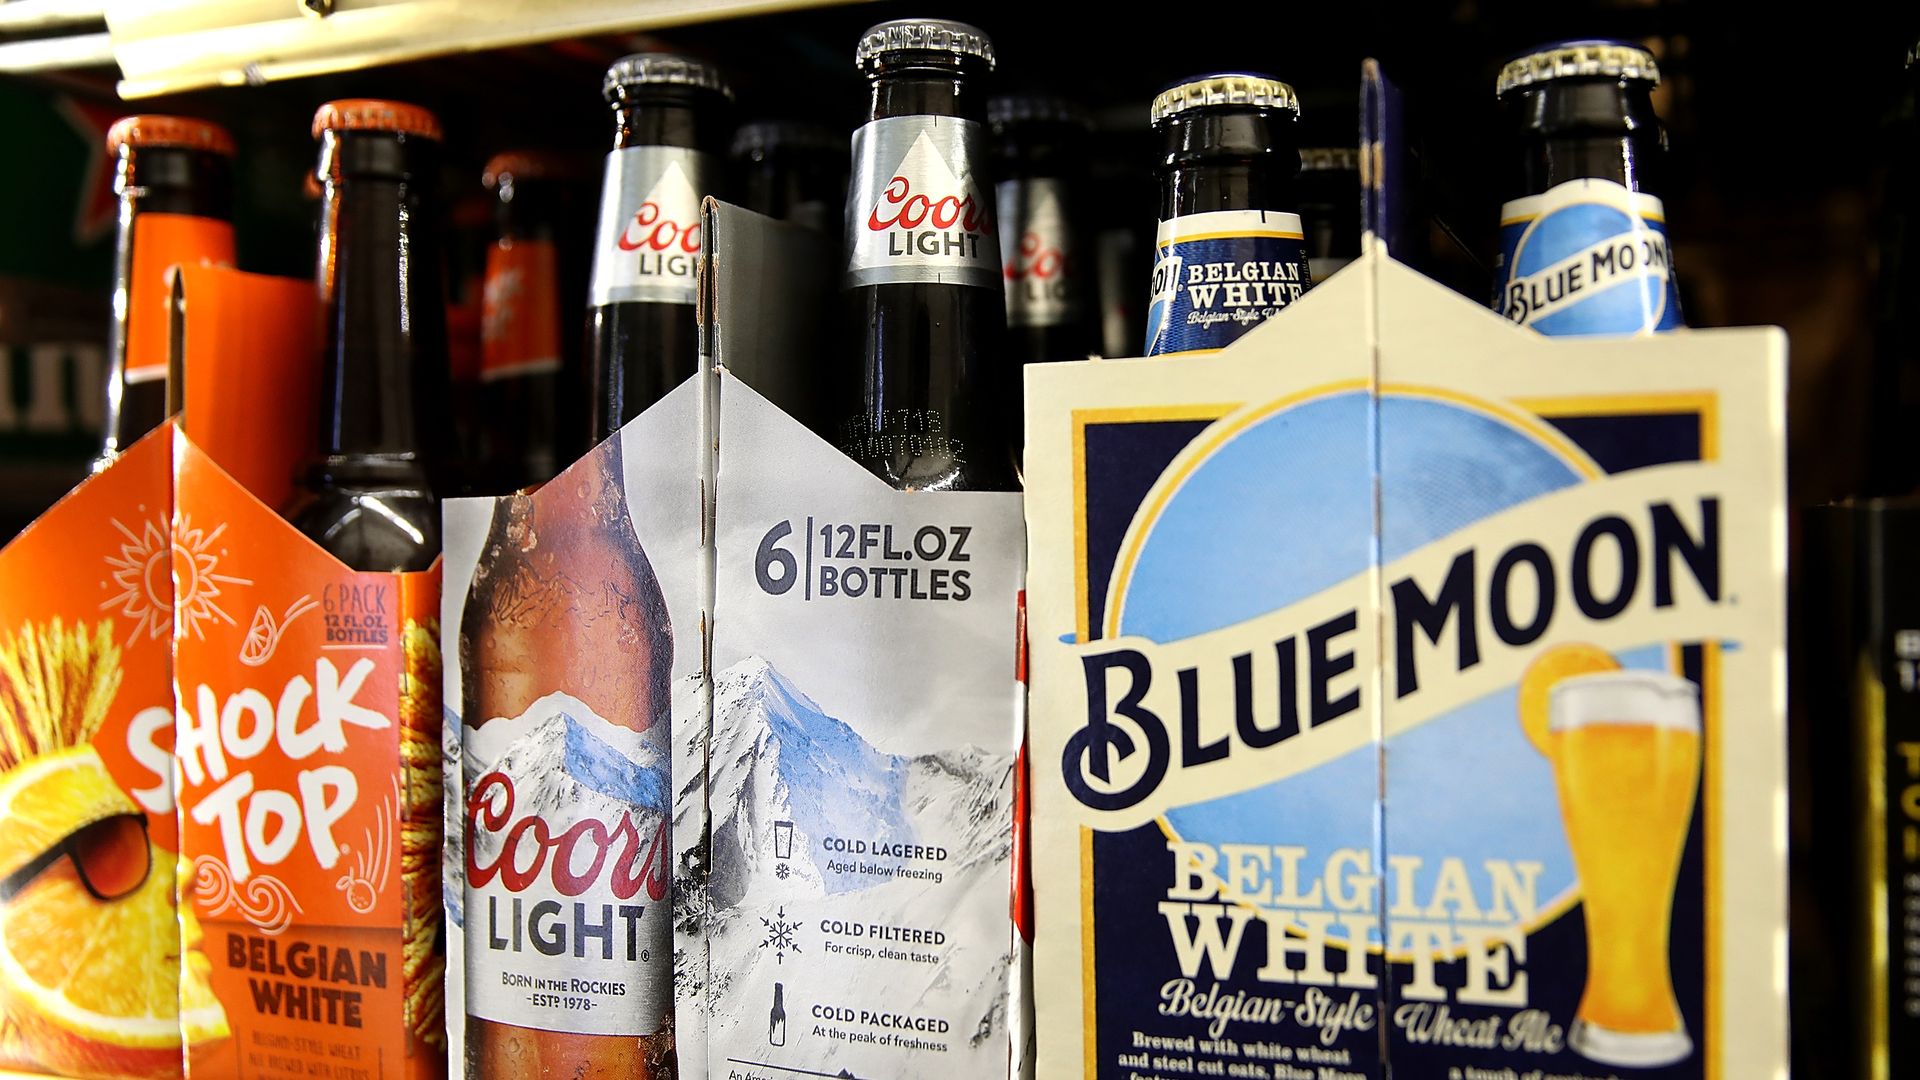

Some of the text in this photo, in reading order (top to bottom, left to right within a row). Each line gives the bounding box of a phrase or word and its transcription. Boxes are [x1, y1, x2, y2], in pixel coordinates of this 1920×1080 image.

[887, 25, 916, 37] TWIST
[919, 25, 936, 37] OFF
[618, 202, 701, 252] Coo
[888, 231, 980, 258] LIGHT
[1187, 262, 1300, 284] BELGIAN
[1187, 283, 1302, 309] WHITE
[1506, 263, 1584, 324] BLUE
[1187, 307, 1260, 330] Belgian-Style
[755, 519, 798, 595] 6
[323, 583, 386, 614] 6 PACK
[820, 566, 972, 601] BOTTLES
[324, 614, 339, 627] 12
[326, 628, 388, 643] BOTTLES
[1061, 496, 1723, 812] BLUE MOON
[126, 656, 392, 815] SHOCK
[191, 765, 359, 884] TOP
[465, 771, 668, 902] Coors
[823, 837, 948, 861] COLD LAGERED
[826, 859, 943, 883] Aged below freezing
[1167, 841, 1544, 922] BELGIAN
[489, 895, 646, 962] LIGHT
[820, 919, 946, 945] COLD FILTERED
[227, 932, 387, 989] BELGIAN
[824, 941, 939, 964] For crisp, clean taste
[1158, 901, 1529, 1007] WHITE
[502, 971, 532, 989] BORN
[547, 978, 568, 992] THE
[571, 978, 626, 996] ROCKIES
[249, 977, 363, 1028] WHITE
[1158, 978, 1566, 1054] Belgian-Style Wheat Ale
[811, 1004, 949, 1033] COLD PACKAGED
[812, 1025, 948, 1052] At the peak of freshness
[1132, 1031, 1351, 1066] Brewed with white wheat
[1118, 1052, 1149, 1068] and
[1153, 1055, 1193, 1073] steel
[1197, 1058, 1225, 1076] cut
[1274, 1063, 1315, 1080] Blue
[1317, 1066, 1366, 1080] Moon
